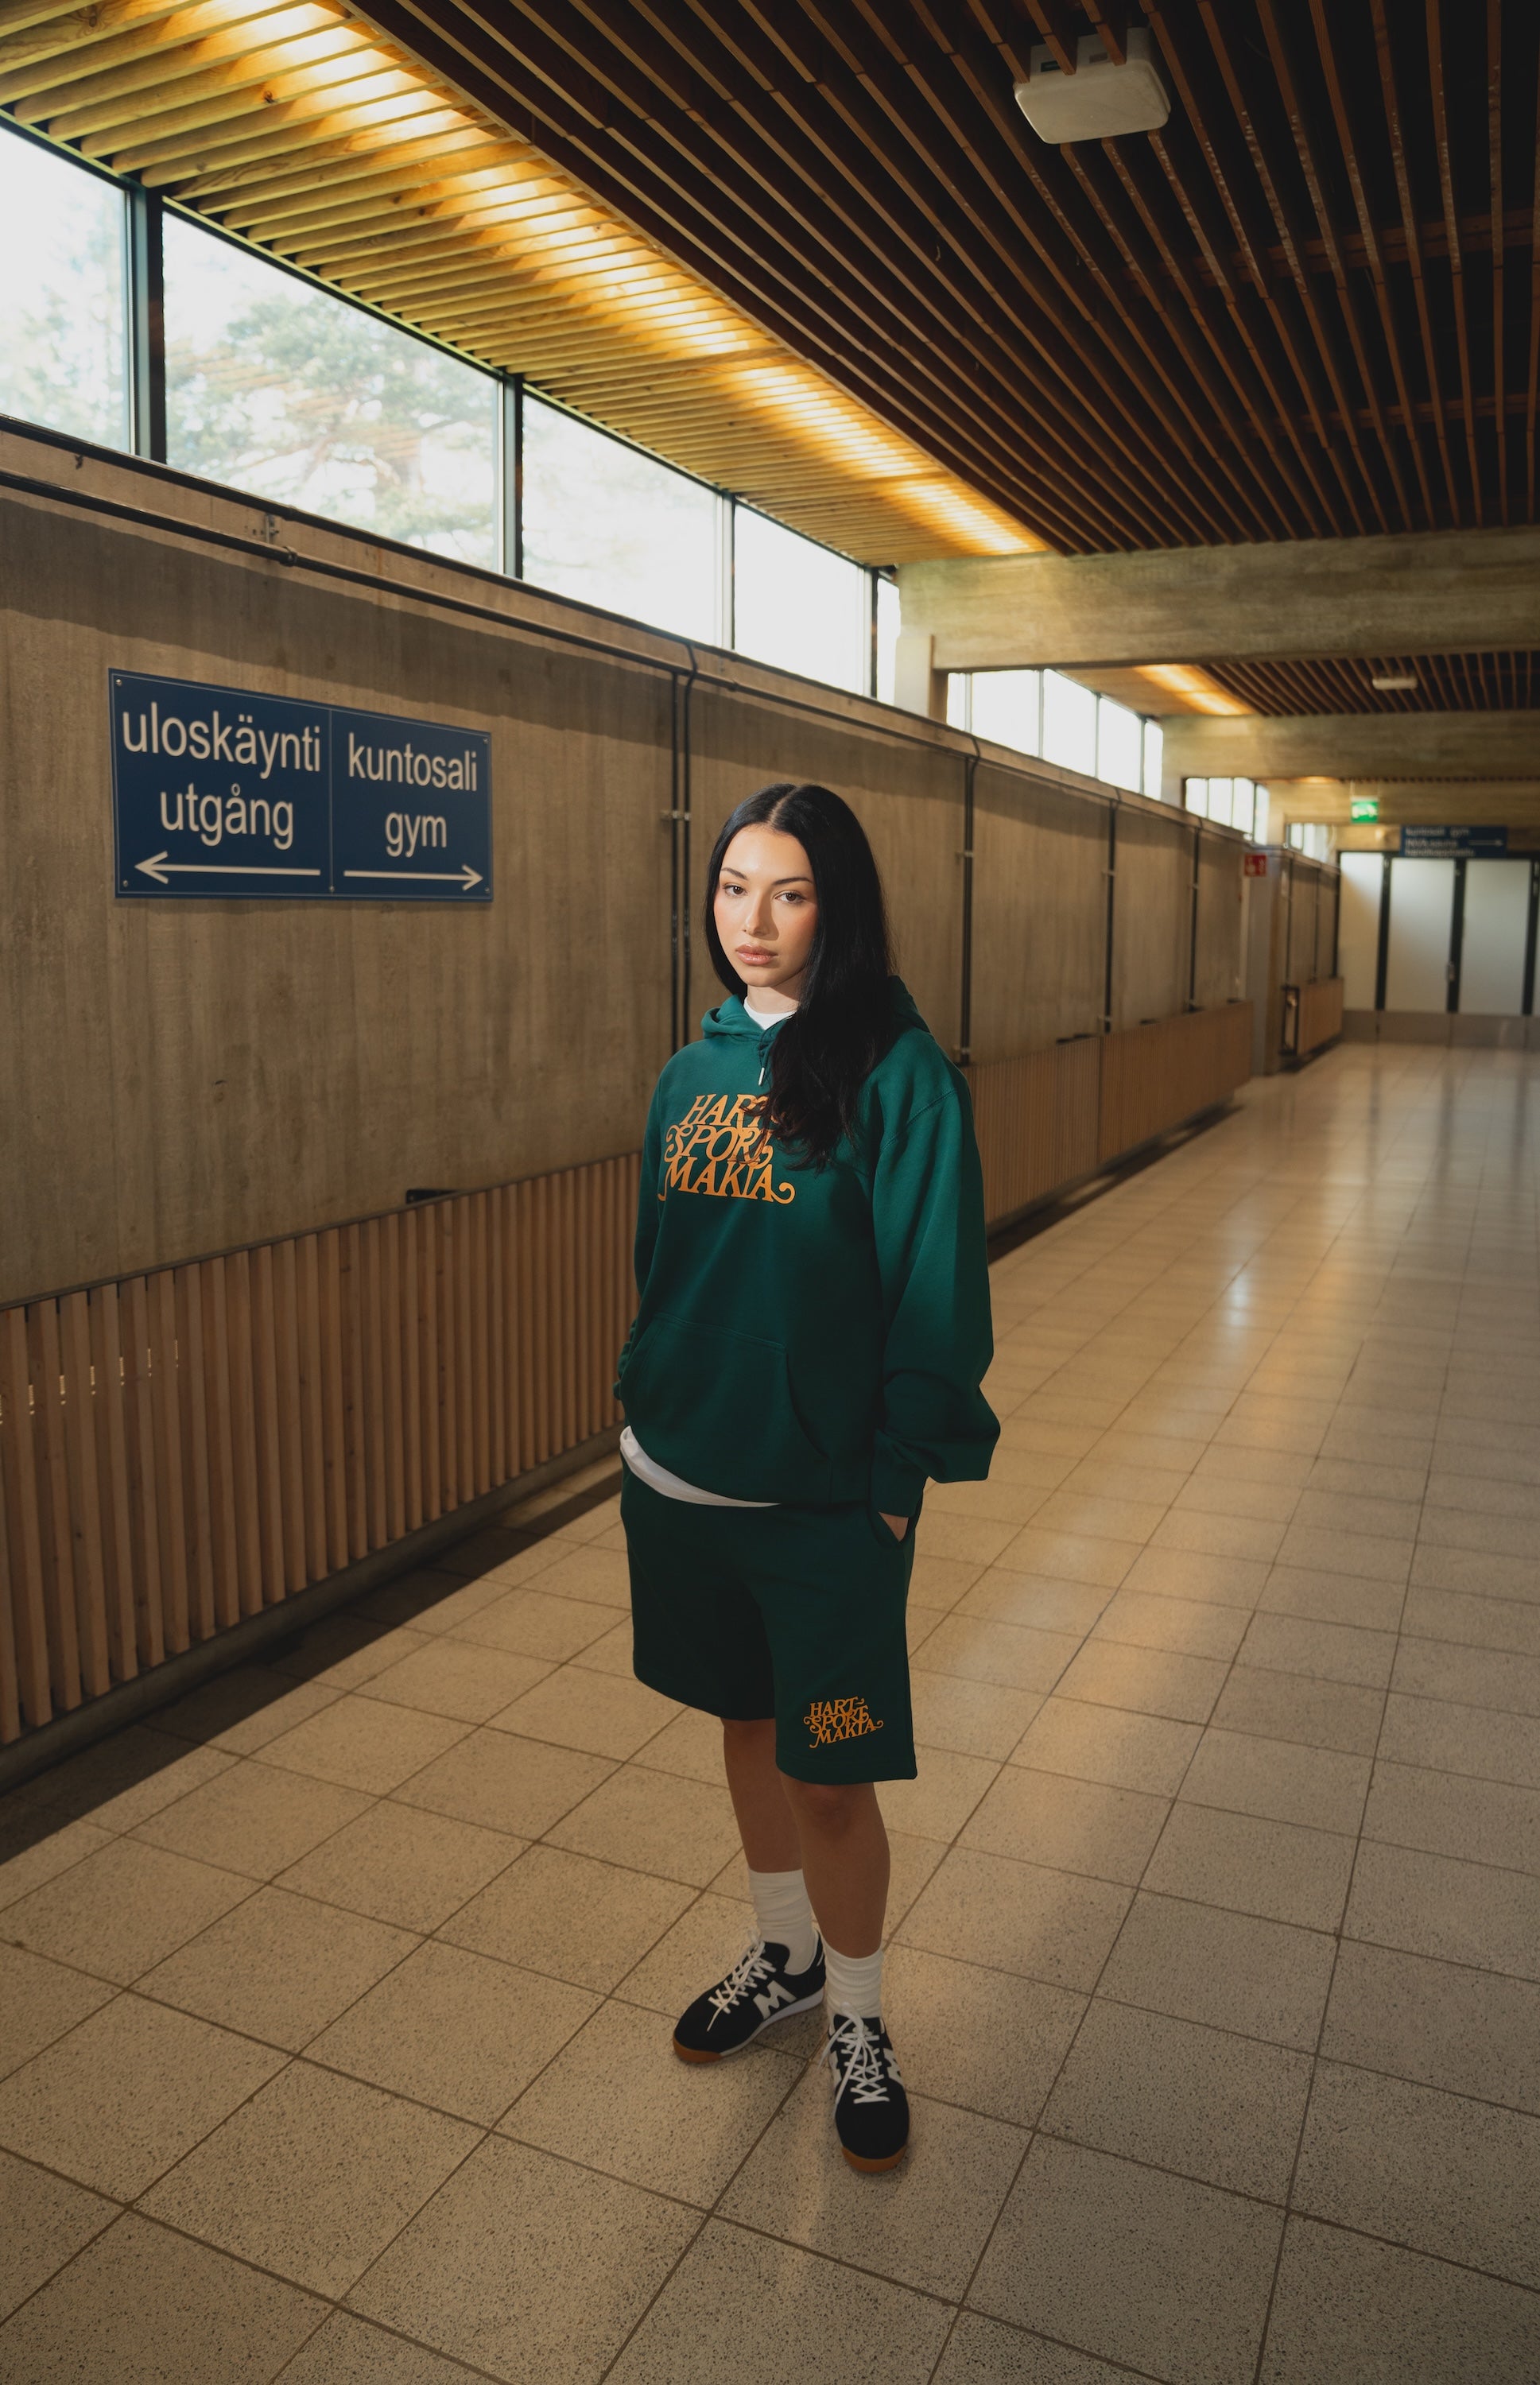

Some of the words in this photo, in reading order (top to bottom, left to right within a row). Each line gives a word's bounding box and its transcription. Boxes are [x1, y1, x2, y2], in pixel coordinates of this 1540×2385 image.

[122, 701, 320, 779] uloskäynti
[347, 731, 477, 792] kuntosali
[161, 782, 293, 850] utgång
[384, 812, 447, 858] gym
[658, 1156, 795, 1204] MAKIA
[803, 1704, 869, 1734] SPORT
[809, 1718, 884, 1748] MAKIA
